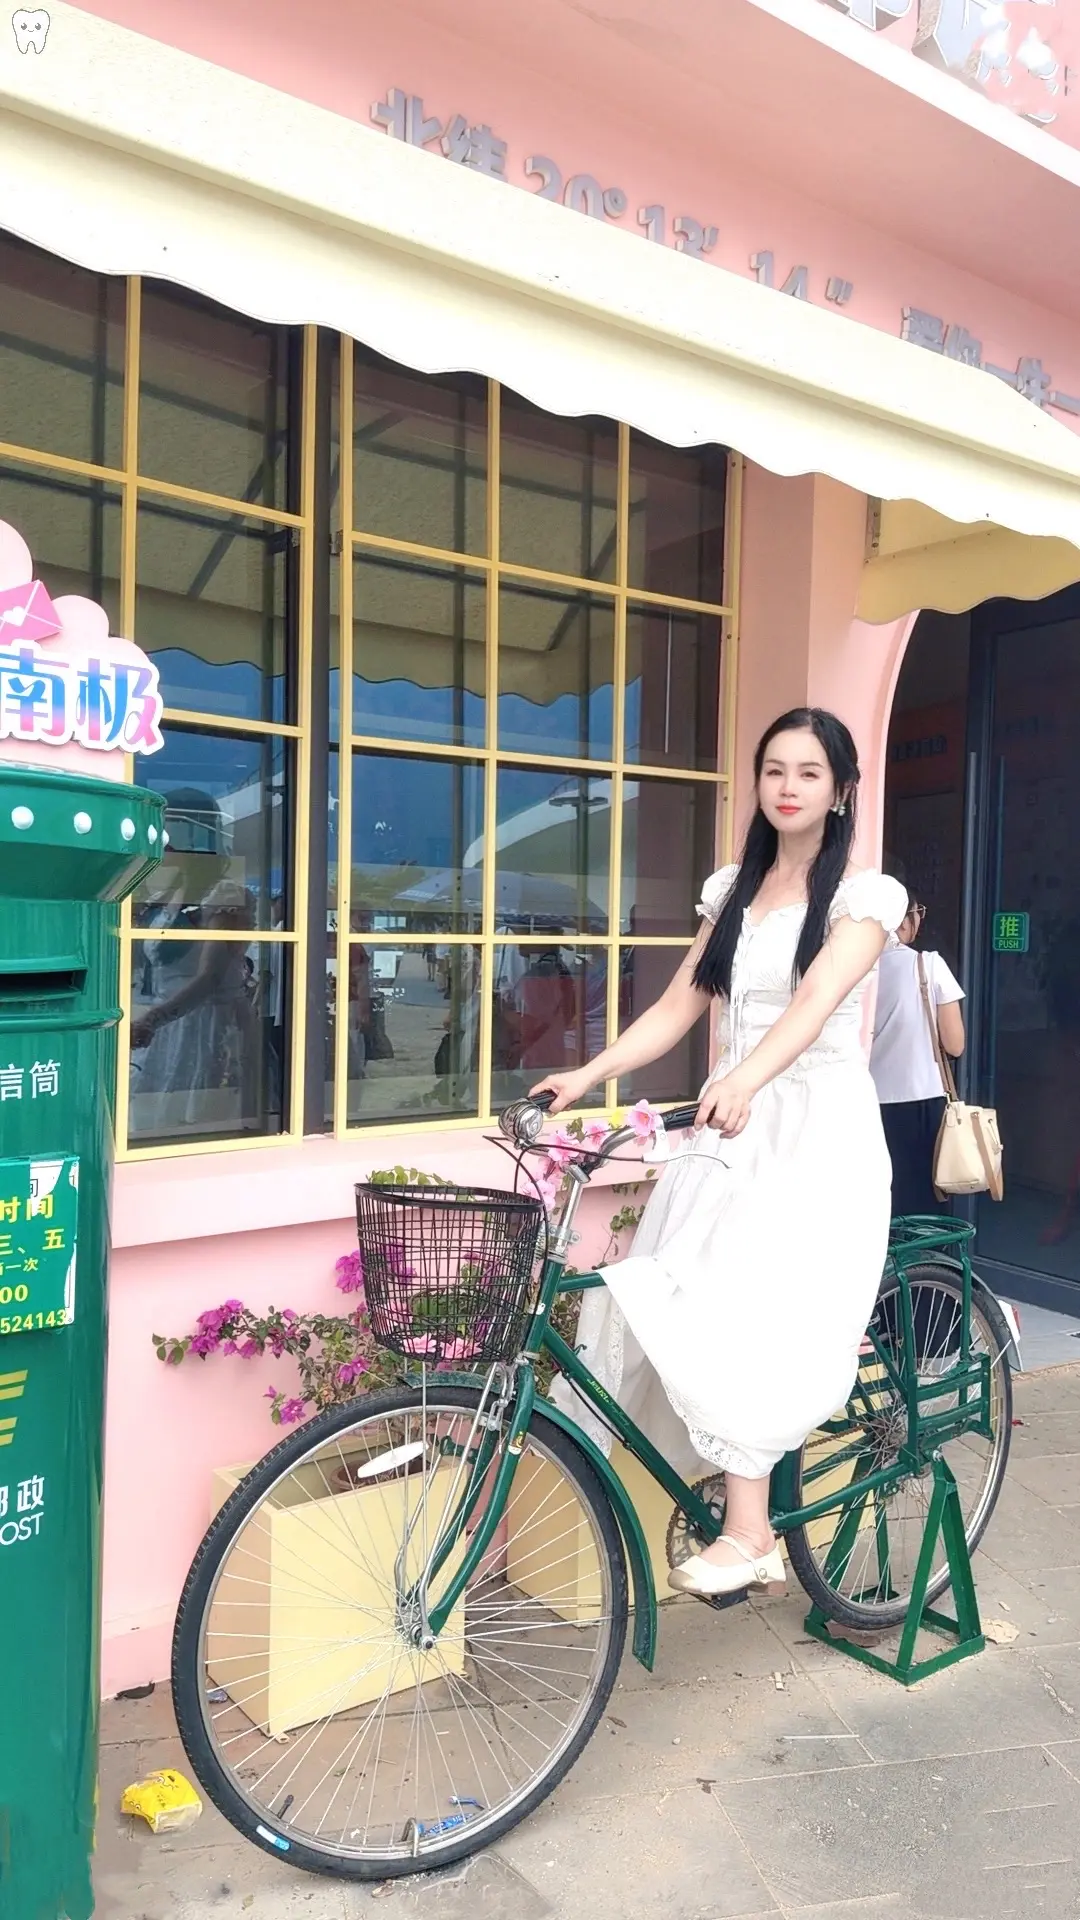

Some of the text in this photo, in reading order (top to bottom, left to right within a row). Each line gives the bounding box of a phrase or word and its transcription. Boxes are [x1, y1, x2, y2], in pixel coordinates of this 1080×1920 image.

[1000, 916, 1019, 937] 推
[998, 939, 1019, 949] PUSH
[0, 1059, 61, 1101] 信筒
[0, 1258, 38, 1276] 一次
[0, 1309, 66, 1334] 524143
